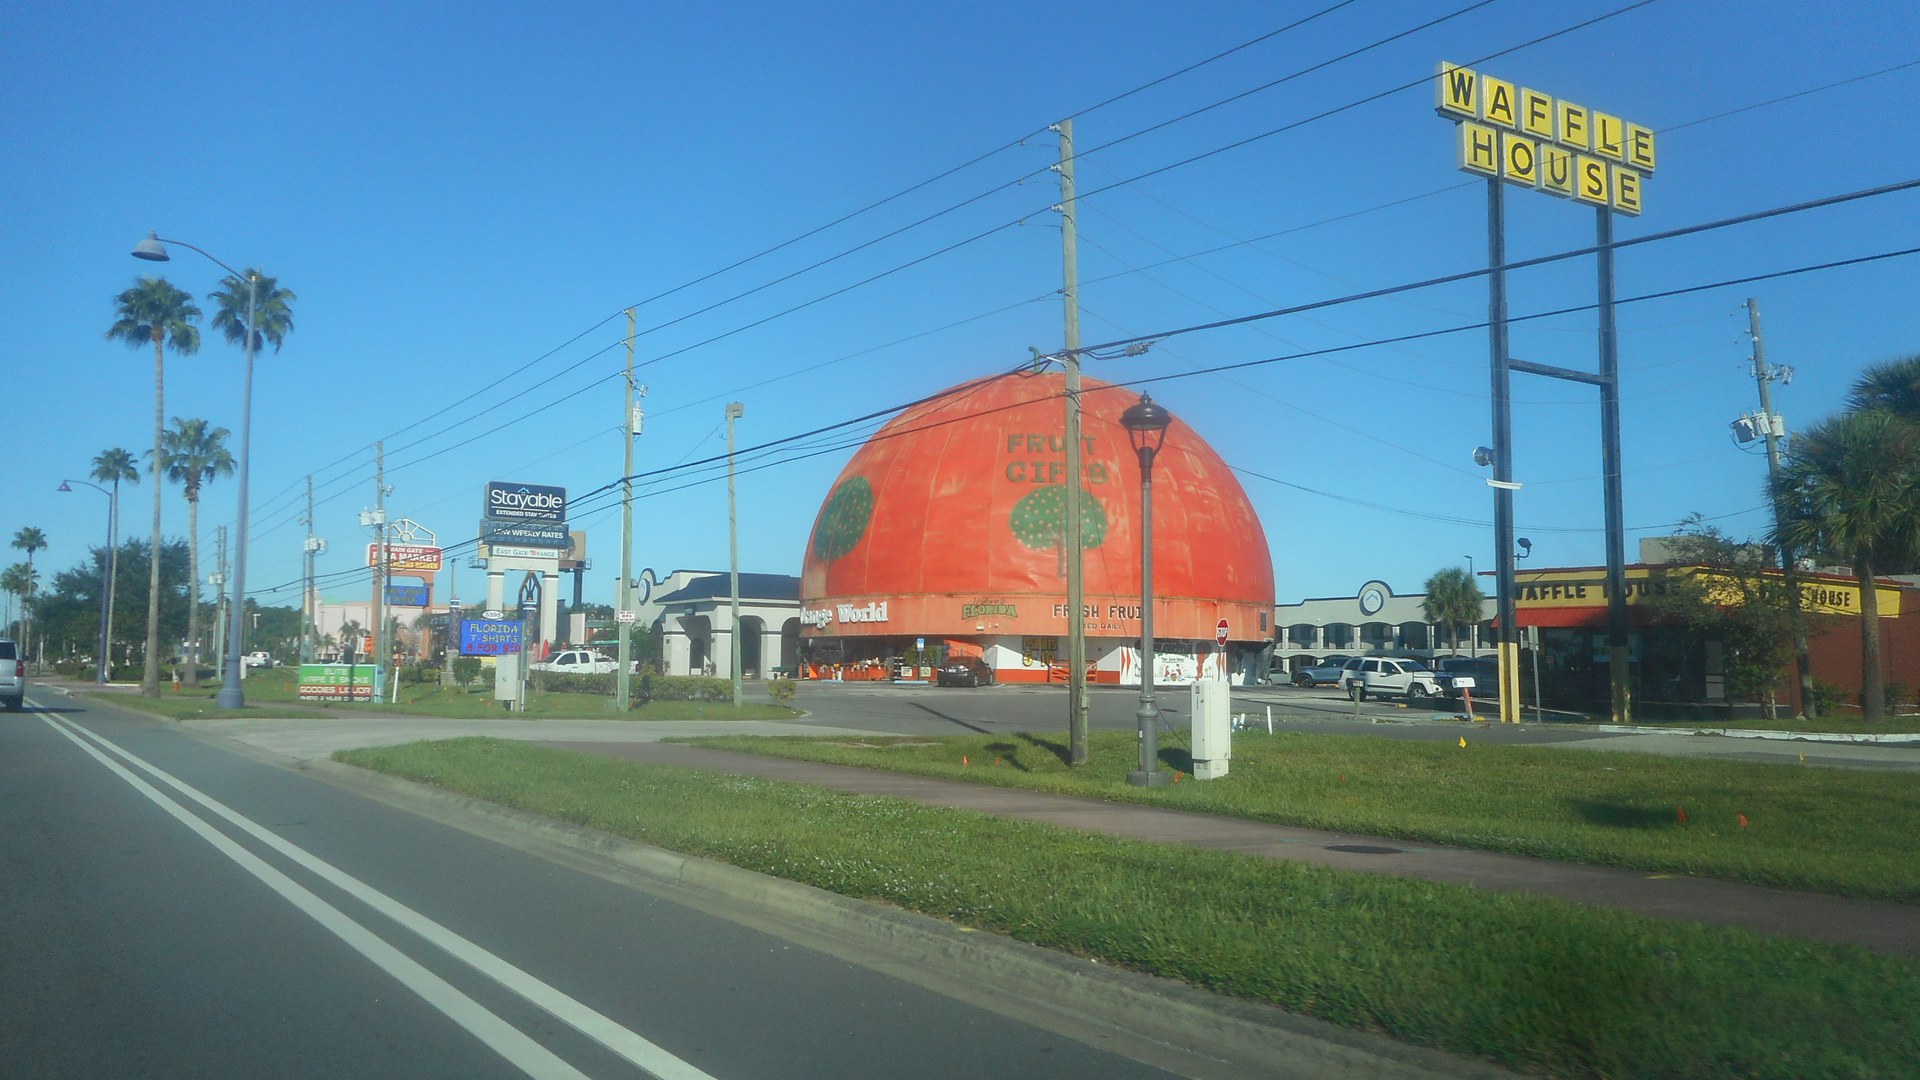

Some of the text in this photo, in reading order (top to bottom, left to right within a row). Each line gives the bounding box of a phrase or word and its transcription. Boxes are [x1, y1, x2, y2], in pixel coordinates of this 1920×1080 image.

[1449, 69, 1651, 162] WAFFLE
[1472, 130, 1637, 206] HOUSE
[1008, 434, 1097, 455] FRUT
[1006, 461, 1108, 484] GIFS
[491, 489, 562, 510] Stayable
[541, 531, 564, 539] RATES
[399, 552, 439, 562] MARKET
[837, 602, 888, 622] World
[961, 604, 1018, 620] FLORIDA
[1053, 604, 1100, 619] FRSH
[470, 623, 518, 633] FLORIDA
[470, 634, 518, 643] T-SHIRTS
[477, 644, 498, 652] FOR
